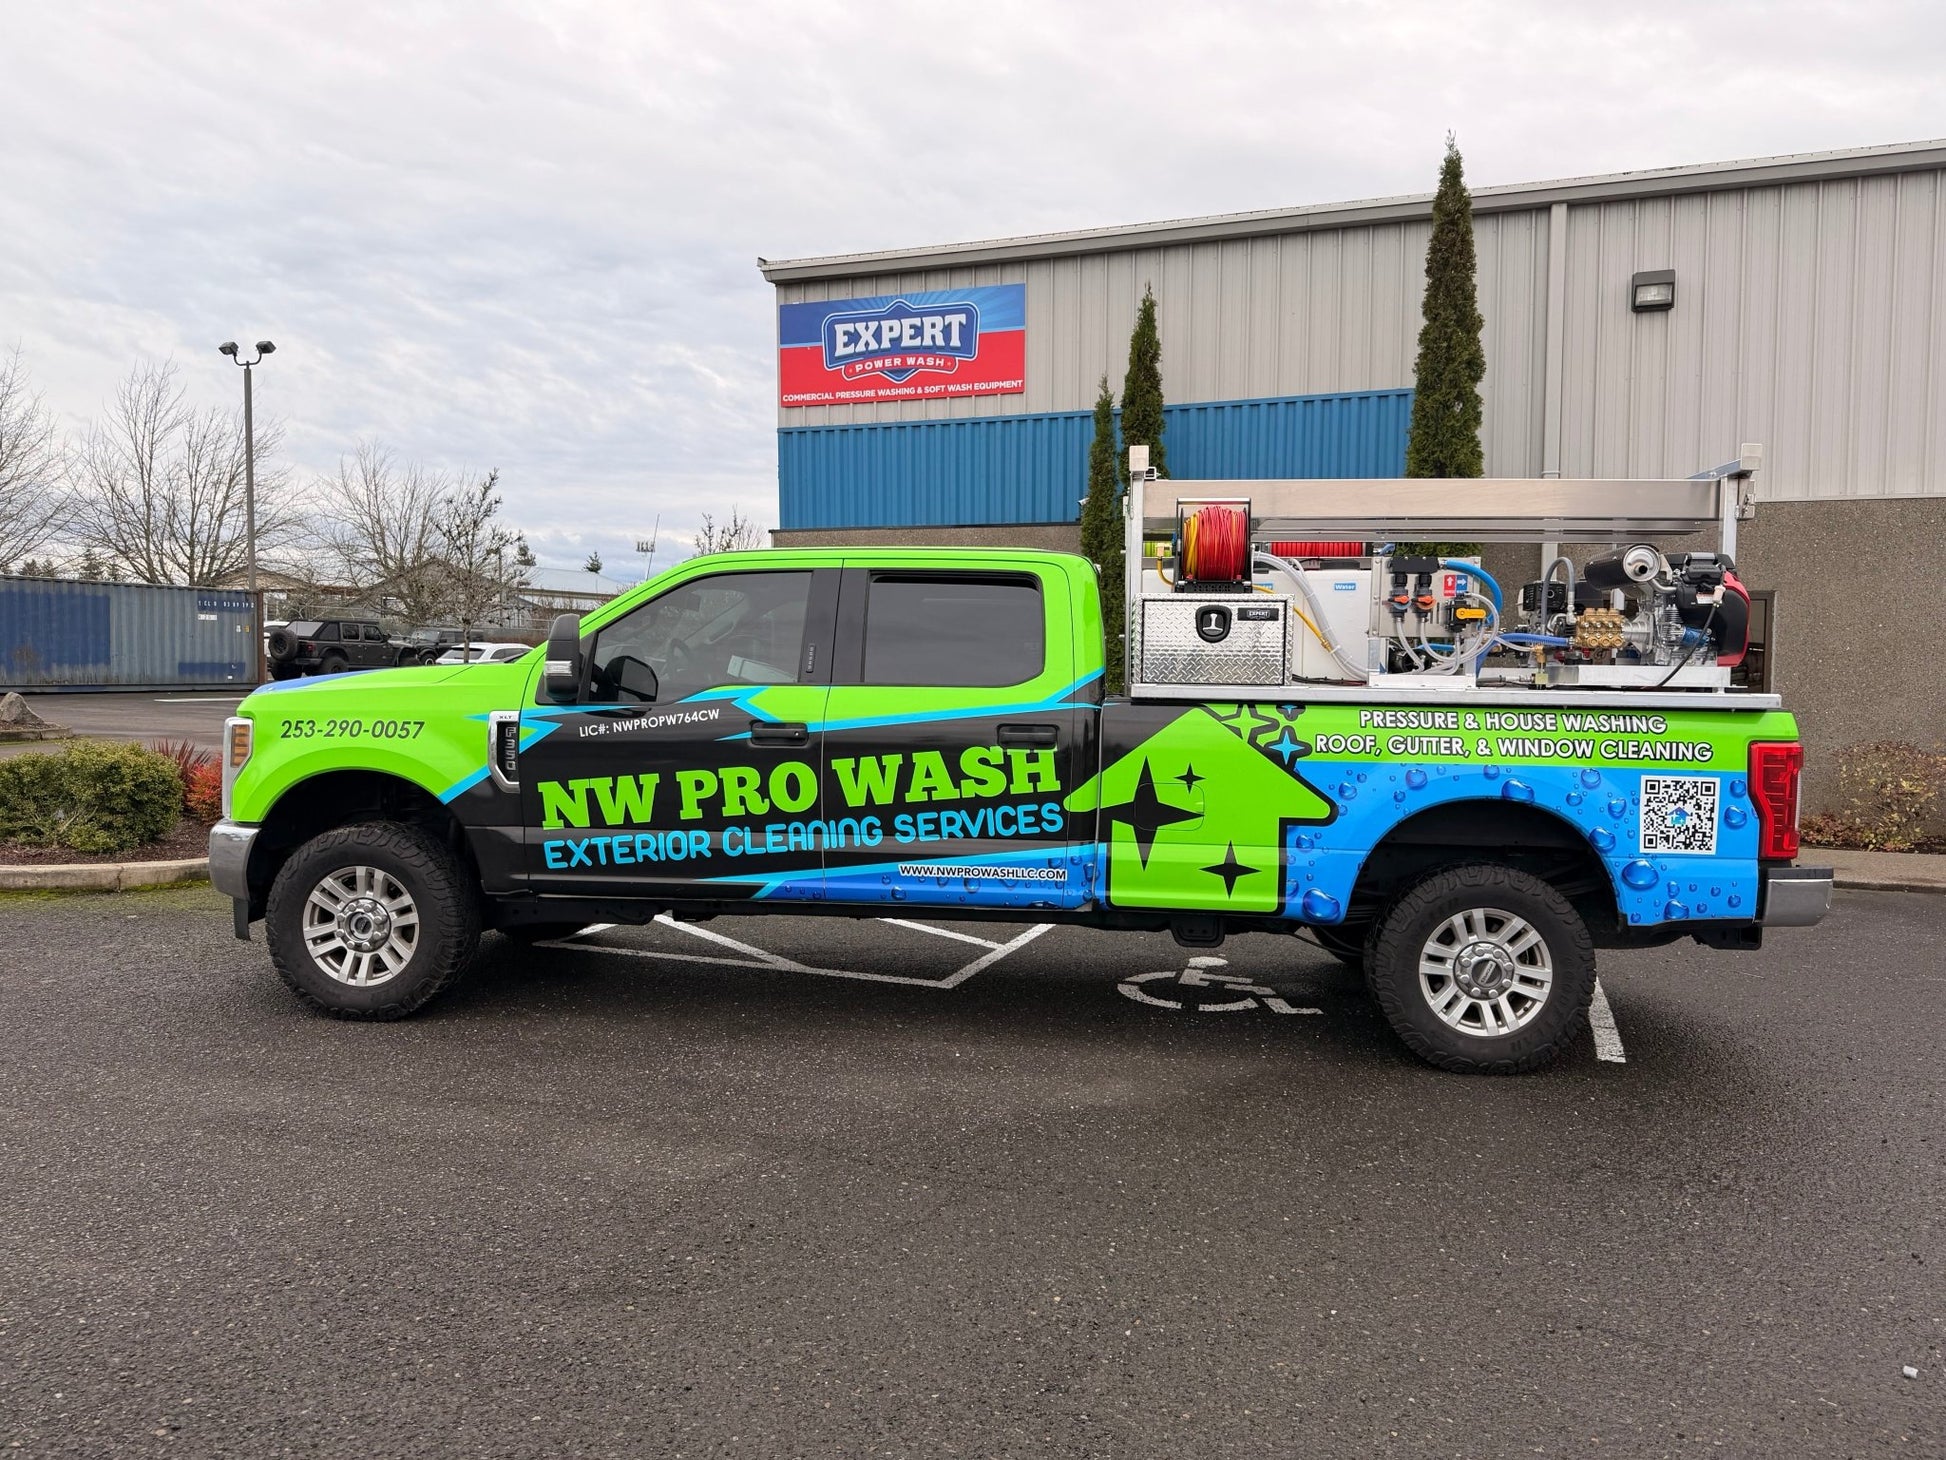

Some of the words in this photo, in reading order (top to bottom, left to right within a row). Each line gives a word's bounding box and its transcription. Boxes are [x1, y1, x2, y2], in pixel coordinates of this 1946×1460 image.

[834, 313, 967, 357] EXPERT
[855, 357, 902, 373] POWER
[906, 356, 945, 367] WASH
[782, 392, 834, 402] COMMERCIAL
[835, 389, 876, 399] PRESSURE
[877, 386, 916, 397] WASHING
[917, 385, 923, 394] &
[923, 384, 946, 394] SOFT
[947, 383, 973, 393] WASH
[973, 379, 1024, 391] EQUIPMENT
[280, 719, 425, 739] 253-290-0057
[579, 724, 610, 738] LIC#:
[613, 708, 720, 733] NWPROPW764CW
[1360, 710, 1459, 730] PRESSURE
[1464, 713, 1480, 730] &
[1485, 712, 1557, 731] HOUSE
[1562, 714, 1667, 734] WASHING
[1315, 734, 1382, 756] ROOF,
[1387, 736, 1470, 757] GUTTER,
[1477, 739, 1492, 756] &
[1497, 738, 1595, 758] WINDOW
[1600, 741, 1714, 762] CLEANING
[537, 773, 660, 830] NW
[675, 761, 818, 820] PRO
[831, 745, 1062, 808] WASH
[544, 829, 712, 870] EXTERIOR
[722, 815, 884, 858] CLEANING
[894, 802, 1064, 844] SERVICES
[900, 865, 1067, 880] WWW.NWPROWASHLLC.COM
